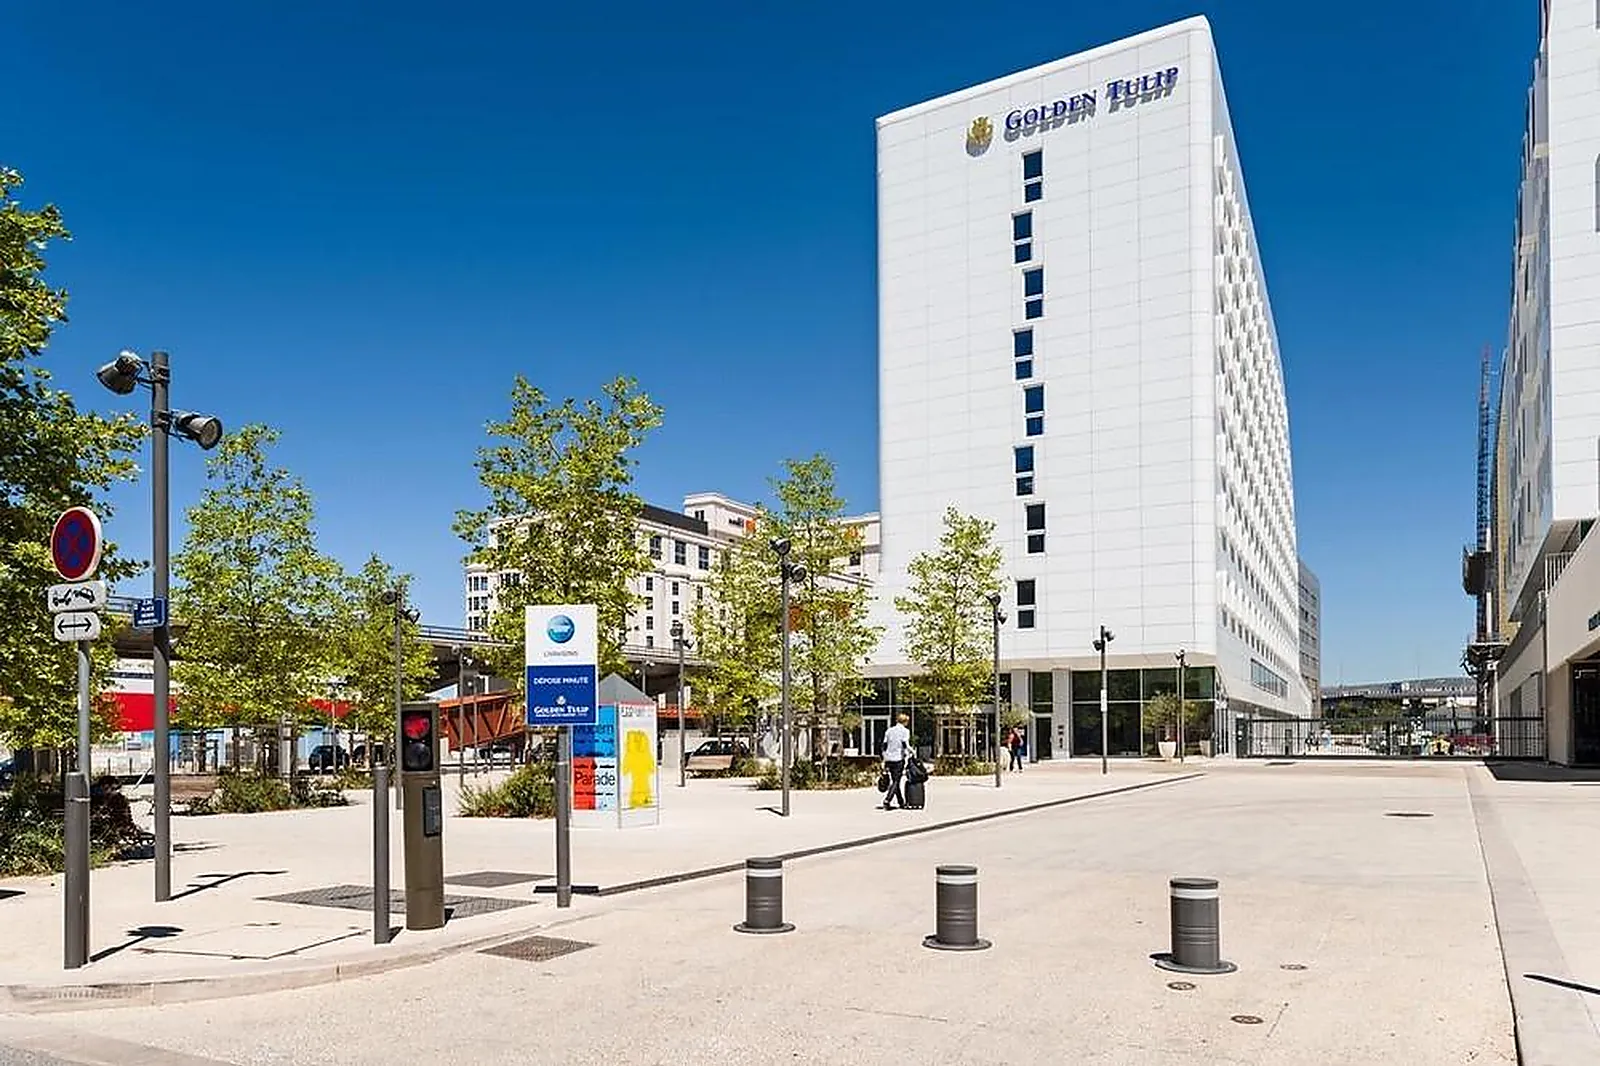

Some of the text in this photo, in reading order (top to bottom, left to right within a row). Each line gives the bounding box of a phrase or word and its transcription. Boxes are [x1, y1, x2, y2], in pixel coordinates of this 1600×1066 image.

[1005, 66, 1179, 131] GOLDEN TULIP
[533, 705, 590, 714] GOLDEN TULIP
[574, 770, 616, 786] Parade
